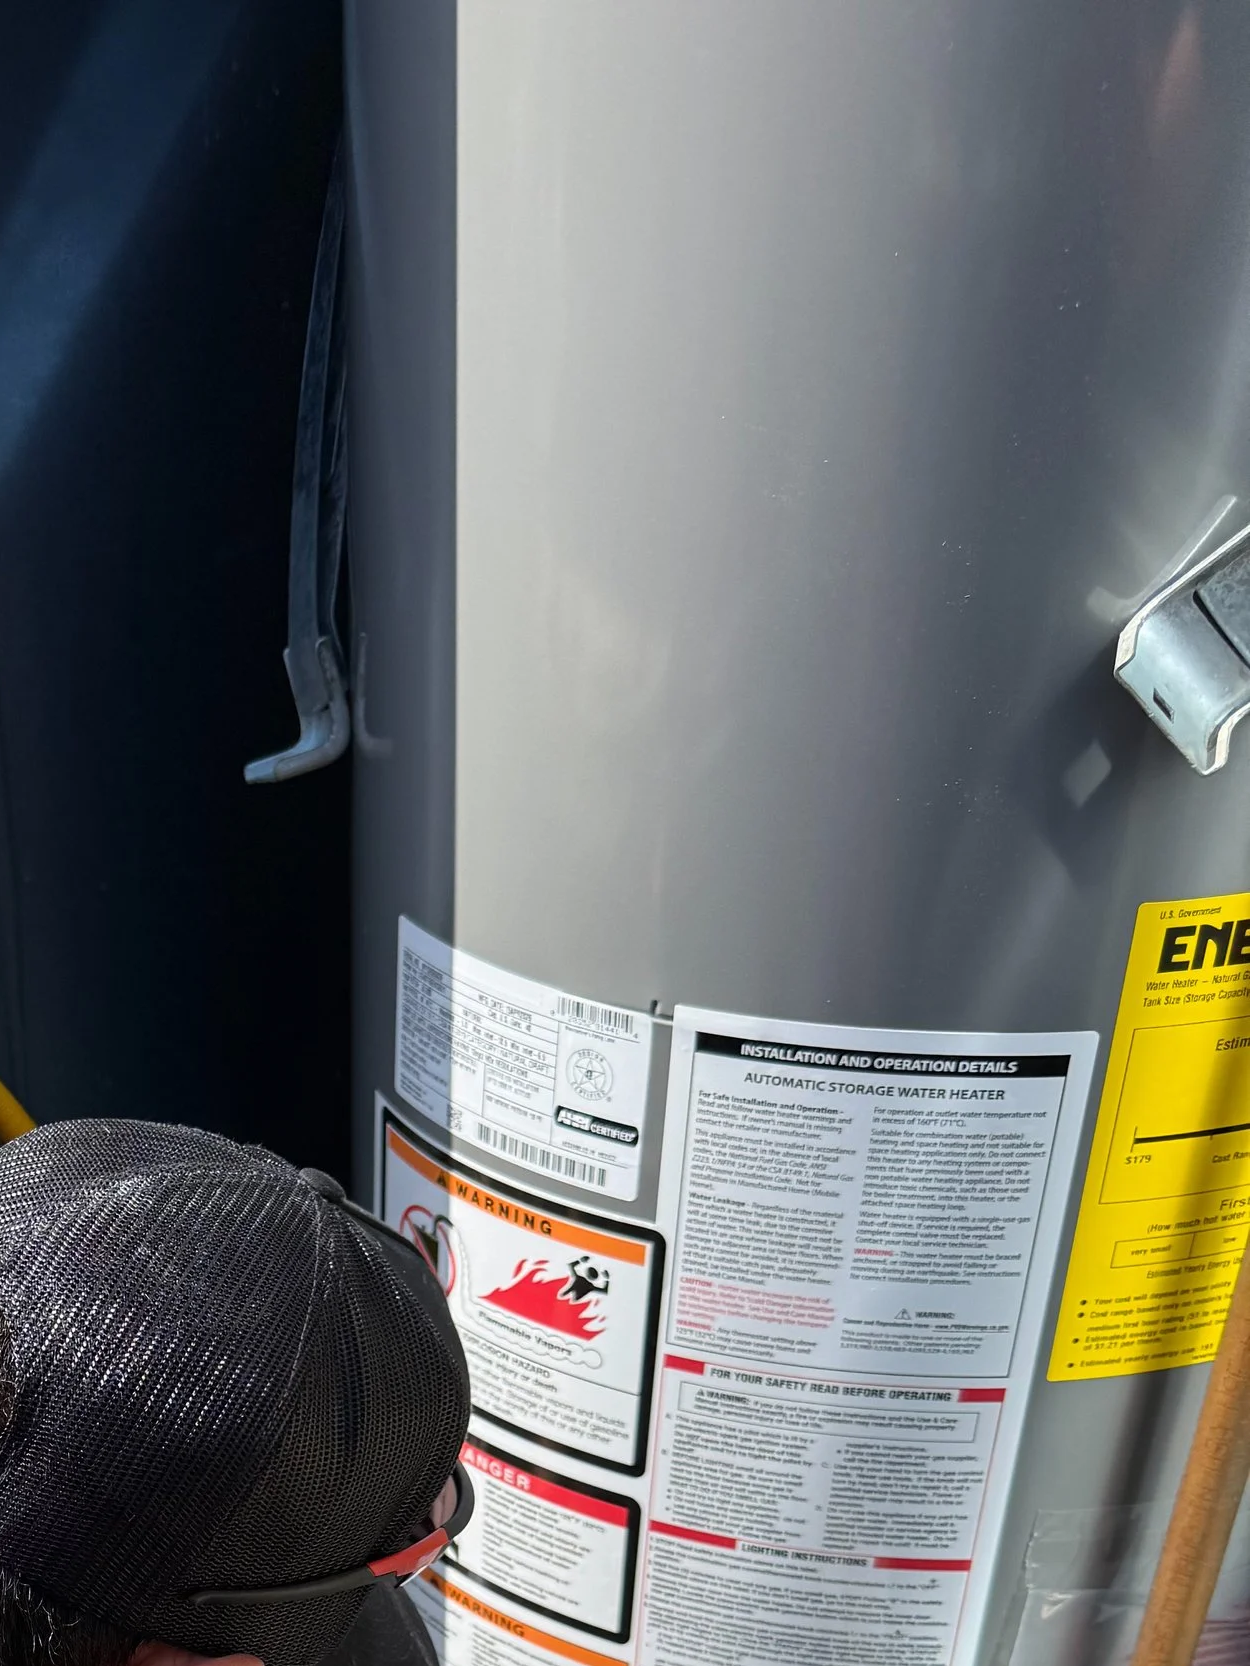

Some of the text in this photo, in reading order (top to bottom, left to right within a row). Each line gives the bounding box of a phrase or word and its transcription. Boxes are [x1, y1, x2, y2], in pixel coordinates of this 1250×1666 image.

[1178, 906, 1222, 918] Government
[1146, 981, 1169, 992] Water
[1172, 978, 1198, 990] Heater
[1211, 972, 1241, 985] Natural
[1143, 997, 1161, 1008] Tank
[741, 1043, 1019, 1074] INSTALLATION AND OPERATION DETAILS
[744, 1072, 1005, 1101] AUTOMATIC STORAGE WATER HEATER
[699, 1090, 710, 1099] For
[712, 1092, 729, 1102] Safe
[731, 1095, 777, 1108] Installation
[797, 1103, 838, 1114] Operation
[874, 1106, 886, 1114] For
[887, 1108, 924, 1117] operation
[925, 1109, 934, 1117] at
[935, 1110, 958, 1118] outlet
[983, 1111, 1032, 1120] temperature
[872, 1115, 880, 1123] in
[907, 1117, 915, 1125] of
[869, 1137, 898, 1148] heating
[900, 1139, 914, 1147] and
[939, 1141, 968, 1151] heating
[870, 1128, 901, 1137] Suitable
[903, 1130, 914, 1138] for
[915, 1131, 963, 1139] combination
[965, 1132, 987, 1140] water
[1124, 1155, 1152, 1166] $179
[455, 1181, 552, 1236] WARNING
[478, 1311, 573, 1357] Flammable Vapors
[710, 1368, 953, 1402] FOR YOUR SAFETY READ BEFORE OPERATING
[463, 1448, 531, 1491] ANGER
[741, 1543, 868, 1567] LIGHTING INSTRUCTIONS
[449, 1587, 525, 1638] WARNING
